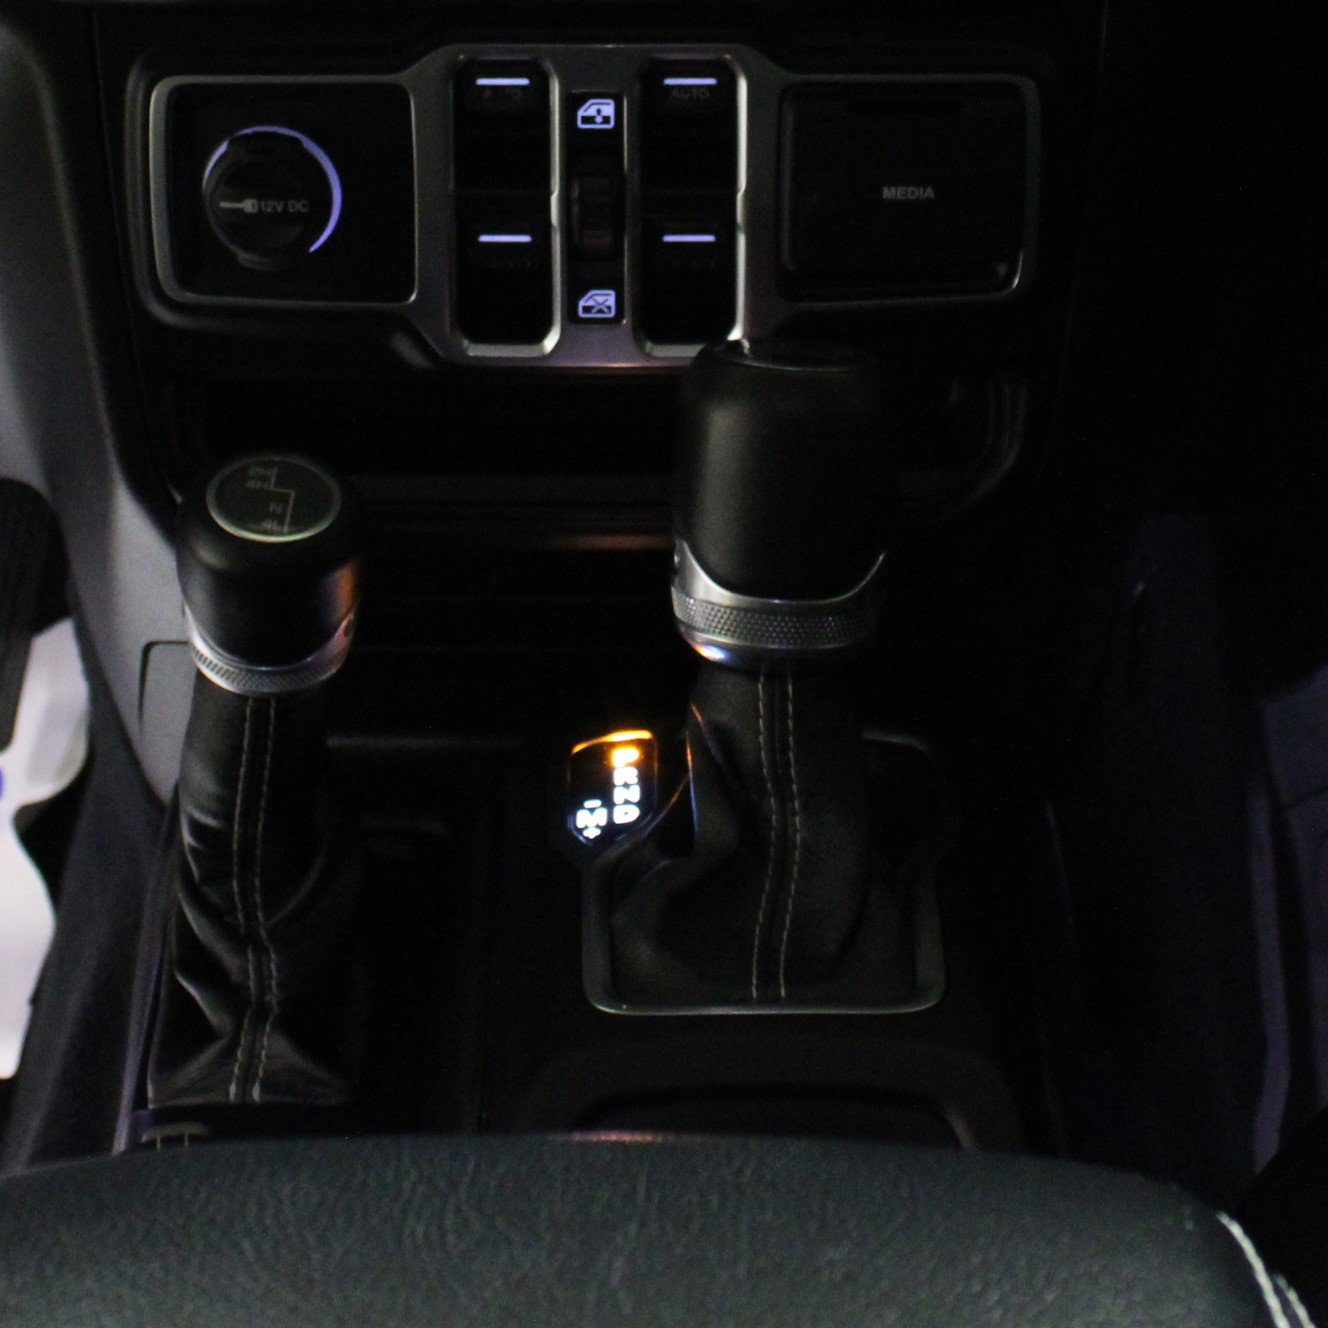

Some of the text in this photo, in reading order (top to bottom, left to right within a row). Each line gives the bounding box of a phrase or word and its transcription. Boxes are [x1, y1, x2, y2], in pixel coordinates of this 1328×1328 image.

[881, 185, 936, 201] MEDIA
[260, 199, 309, 213] 12V DC
[612, 746, 641, 768] P
[612, 803, 641, 825] D
